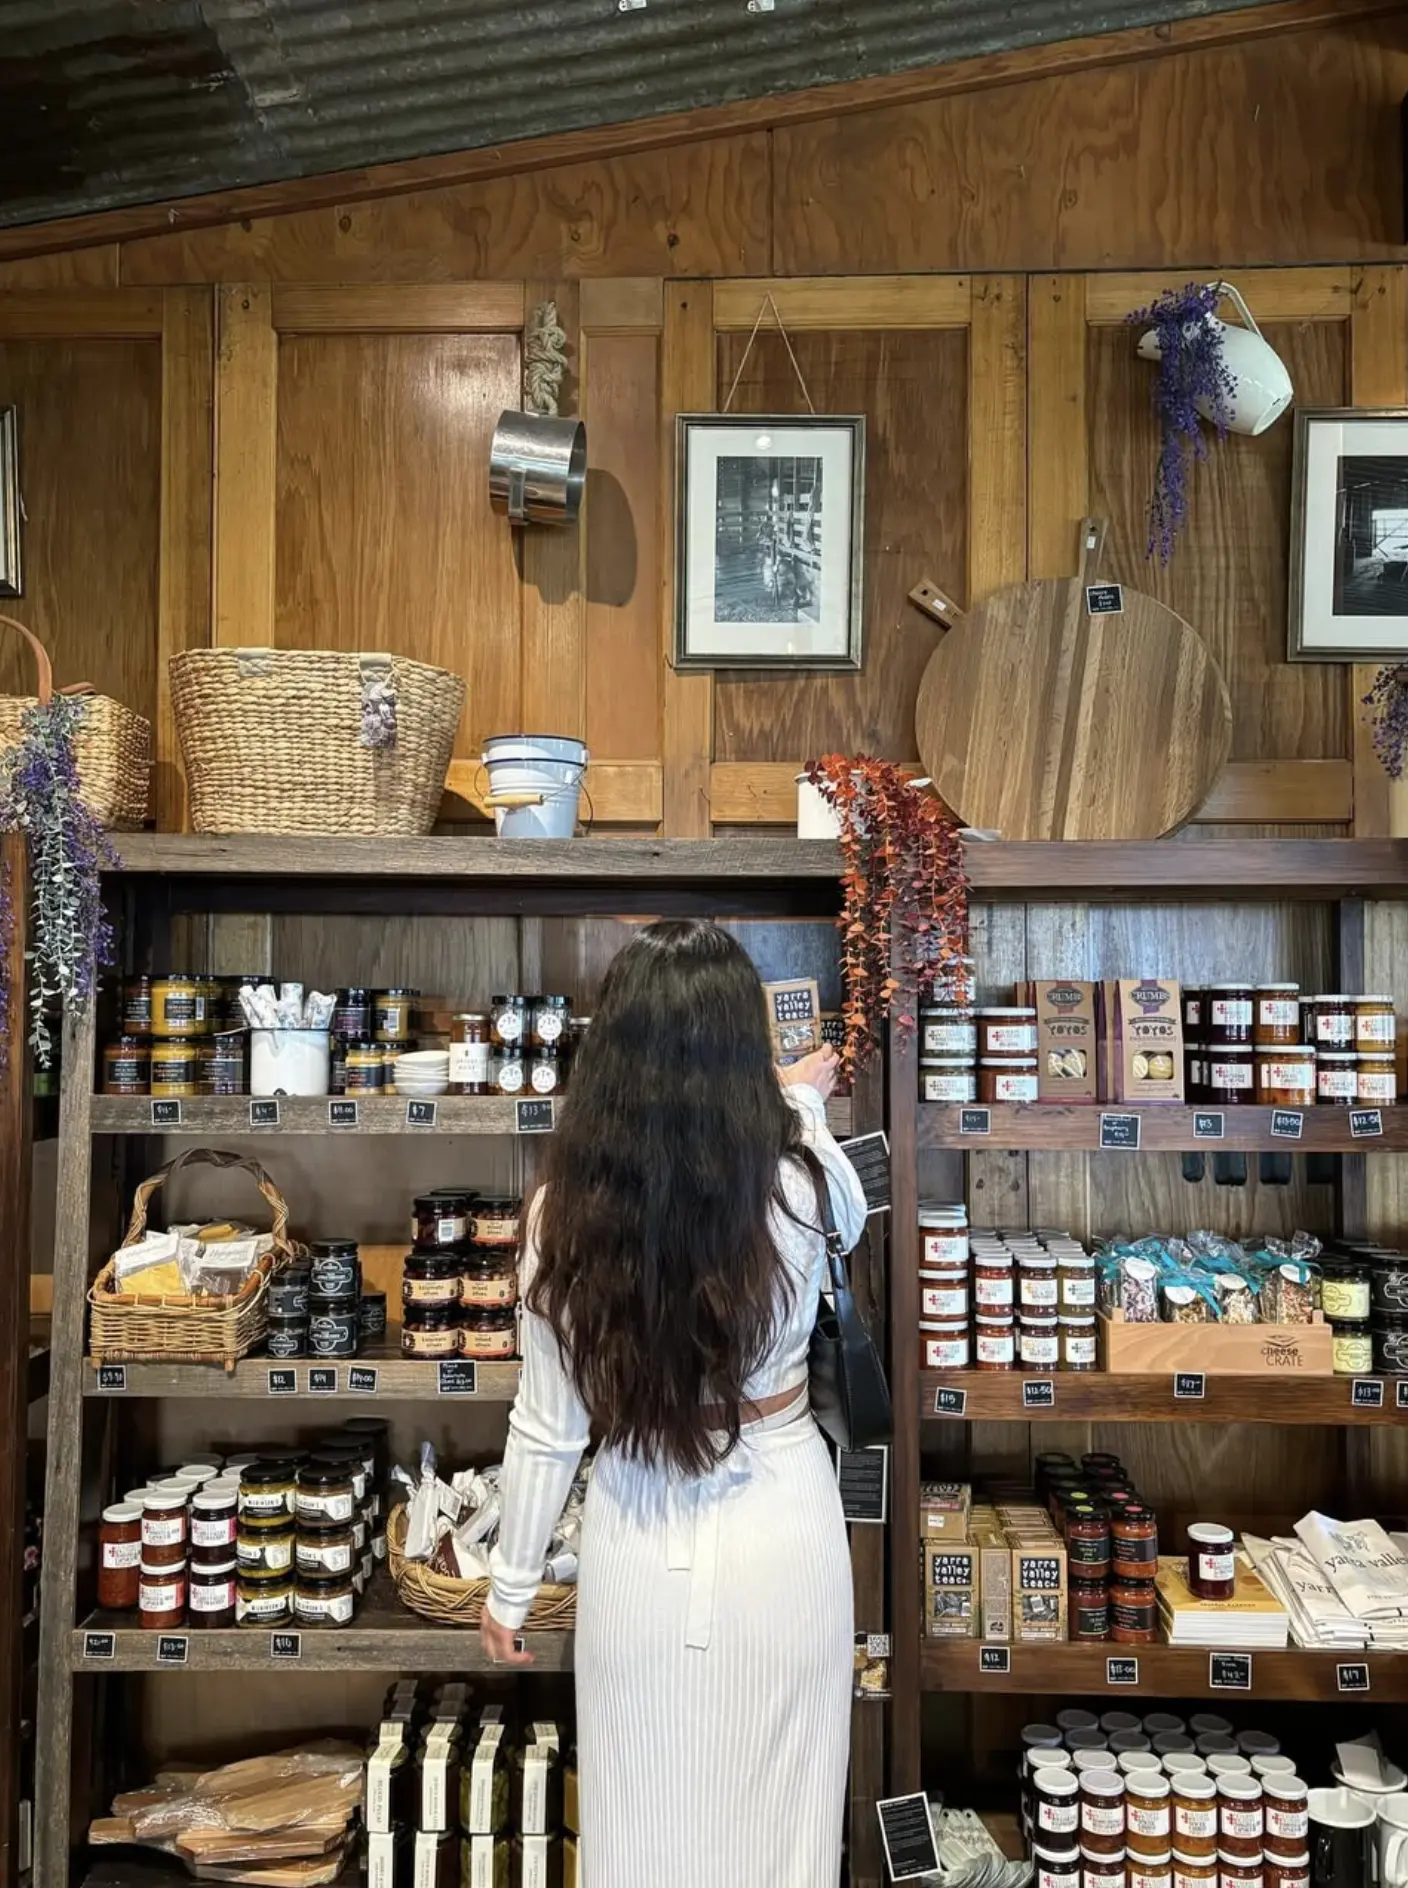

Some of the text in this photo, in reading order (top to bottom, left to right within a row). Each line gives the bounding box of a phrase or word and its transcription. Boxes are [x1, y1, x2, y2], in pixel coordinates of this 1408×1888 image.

[776, 991, 808, 1003] yarra
[776, 1001, 810, 1012] valley
[412, 1104, 426, 1117] $7
[1260, 1347, 1298, 1356] cheese
[1266, 1355, 1304, 1366] CRATE
[934, 1556, 969, 1566] yarra
[1022, 1559, 1056, 1569] yarra
[1324, 1555, 1367, 1573] yarra
[934, 1565, 970, 1577] valley
[1022, 1568, 1058, 1580] valley
